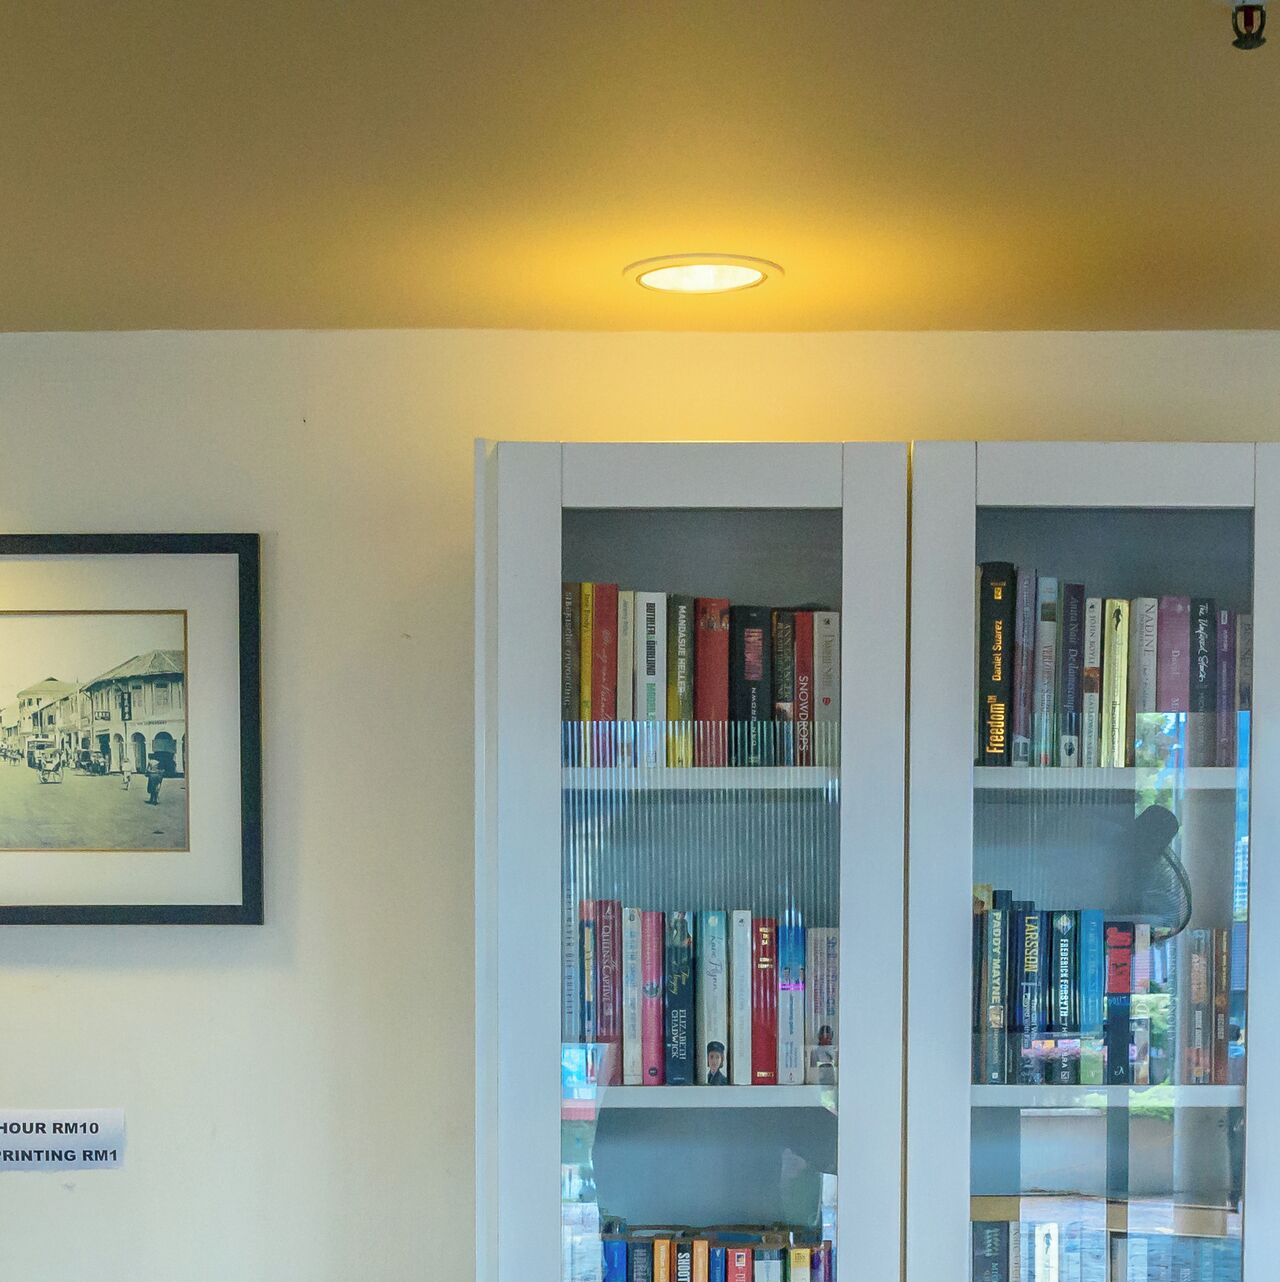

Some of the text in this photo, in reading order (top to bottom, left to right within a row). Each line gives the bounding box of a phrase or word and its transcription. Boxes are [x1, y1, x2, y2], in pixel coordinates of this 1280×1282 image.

[677, 605, 687, 694] MANDASUE HELLER
[991, 620, 1003, 682] Daniel Suarez
[798, 675, 809, 751] SNOWDROPS
[992, 911, 1002, 1004] PADDY MAYNE
[1024, 916, 1039, 973] LARSSON
[1060, 939, 1069, 1017] FREDERICK FORSYTH
[670, 1009, 678, 1058] CHADWICK
[678, 1009, 687, 1059] ELIZABETH
[52, 1122, 99, 1134] RM10
[82, 1150, 117, 1162] RM1
[677, 1252, 690, 1282] SHOOT
